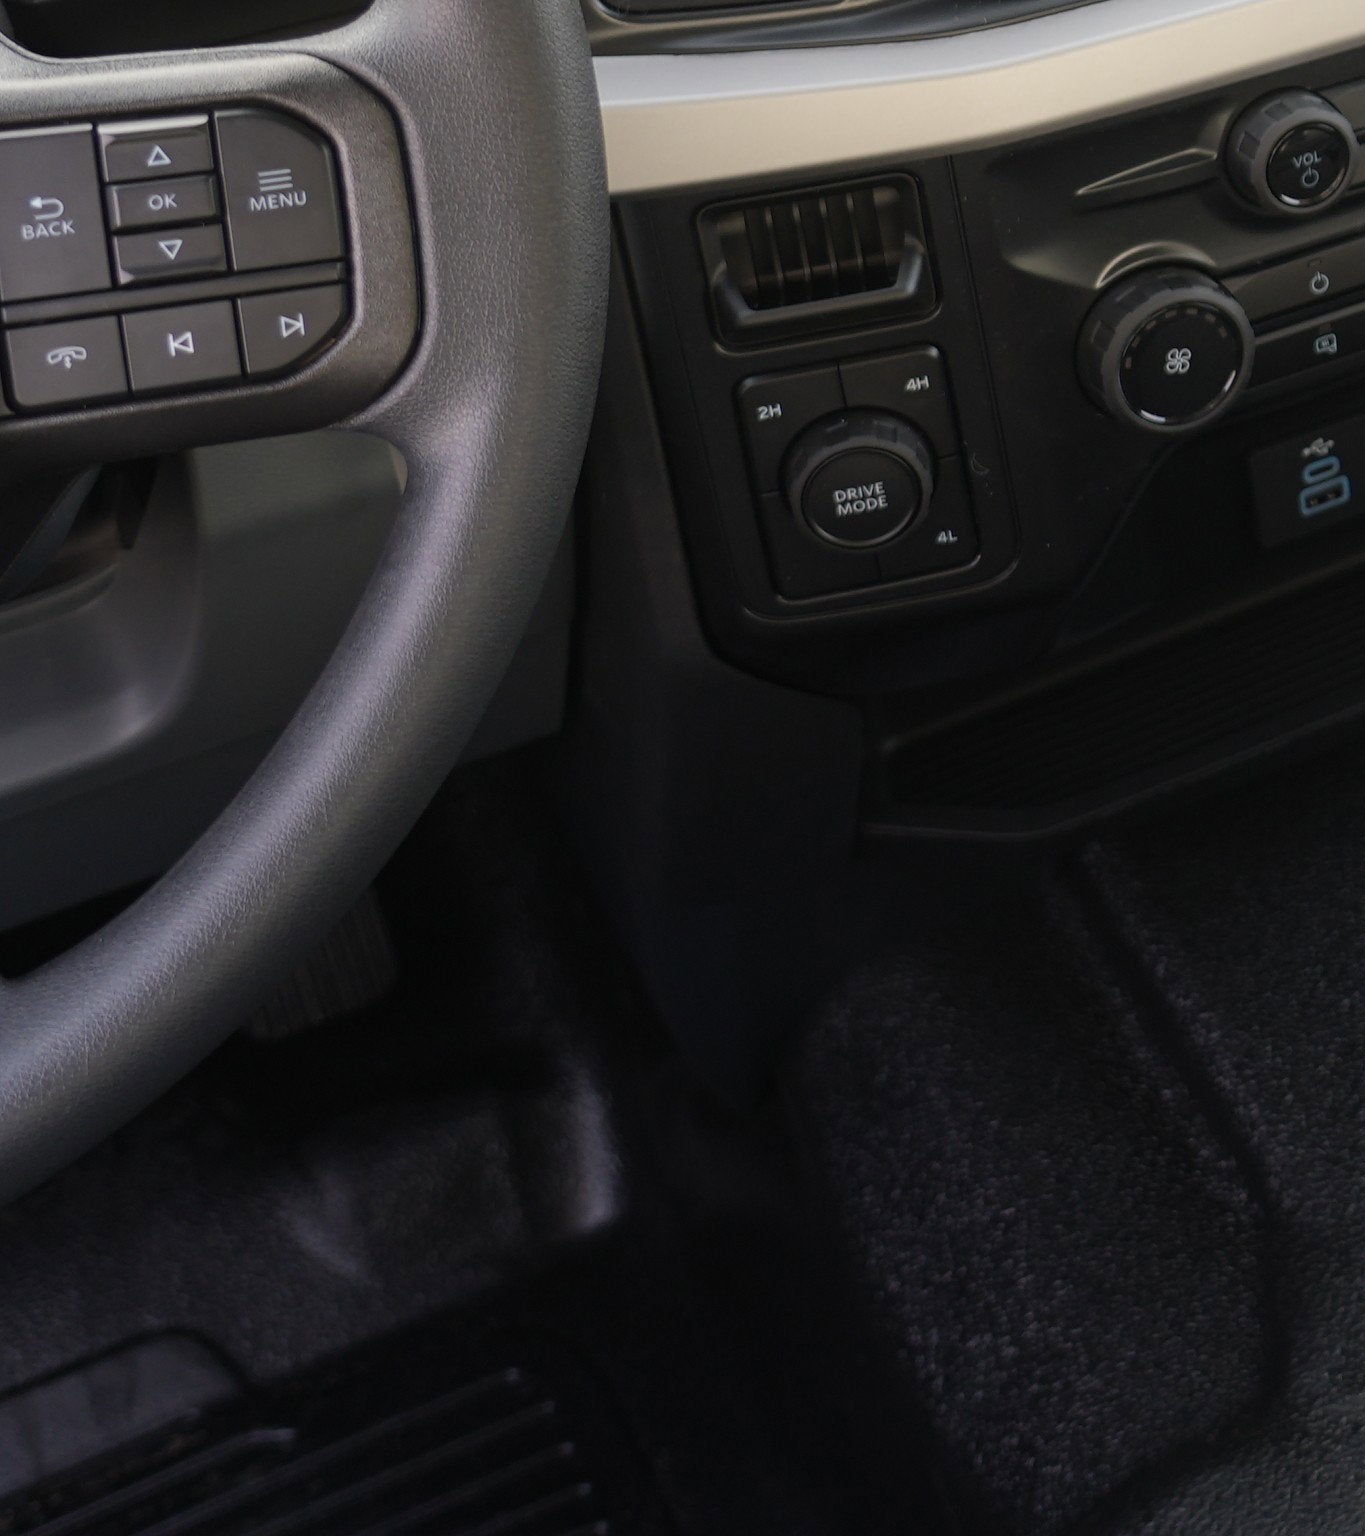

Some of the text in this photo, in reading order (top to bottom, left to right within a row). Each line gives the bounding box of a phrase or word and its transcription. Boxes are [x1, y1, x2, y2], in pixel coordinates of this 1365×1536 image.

[1293, 151, 1322, 169] VOL
[148, 194, 178, 210] OK
[250, 190, 307, 212] MENU
[21, 219, 75, 240] BACK
[904, 375, 930, 392] 4H
[757, 403, 782, 421] 2H
[833, 481, 885, 504] DRIVE
[836, 496, 888, 517] MODE
[935, 530, 958, 544] 4L
